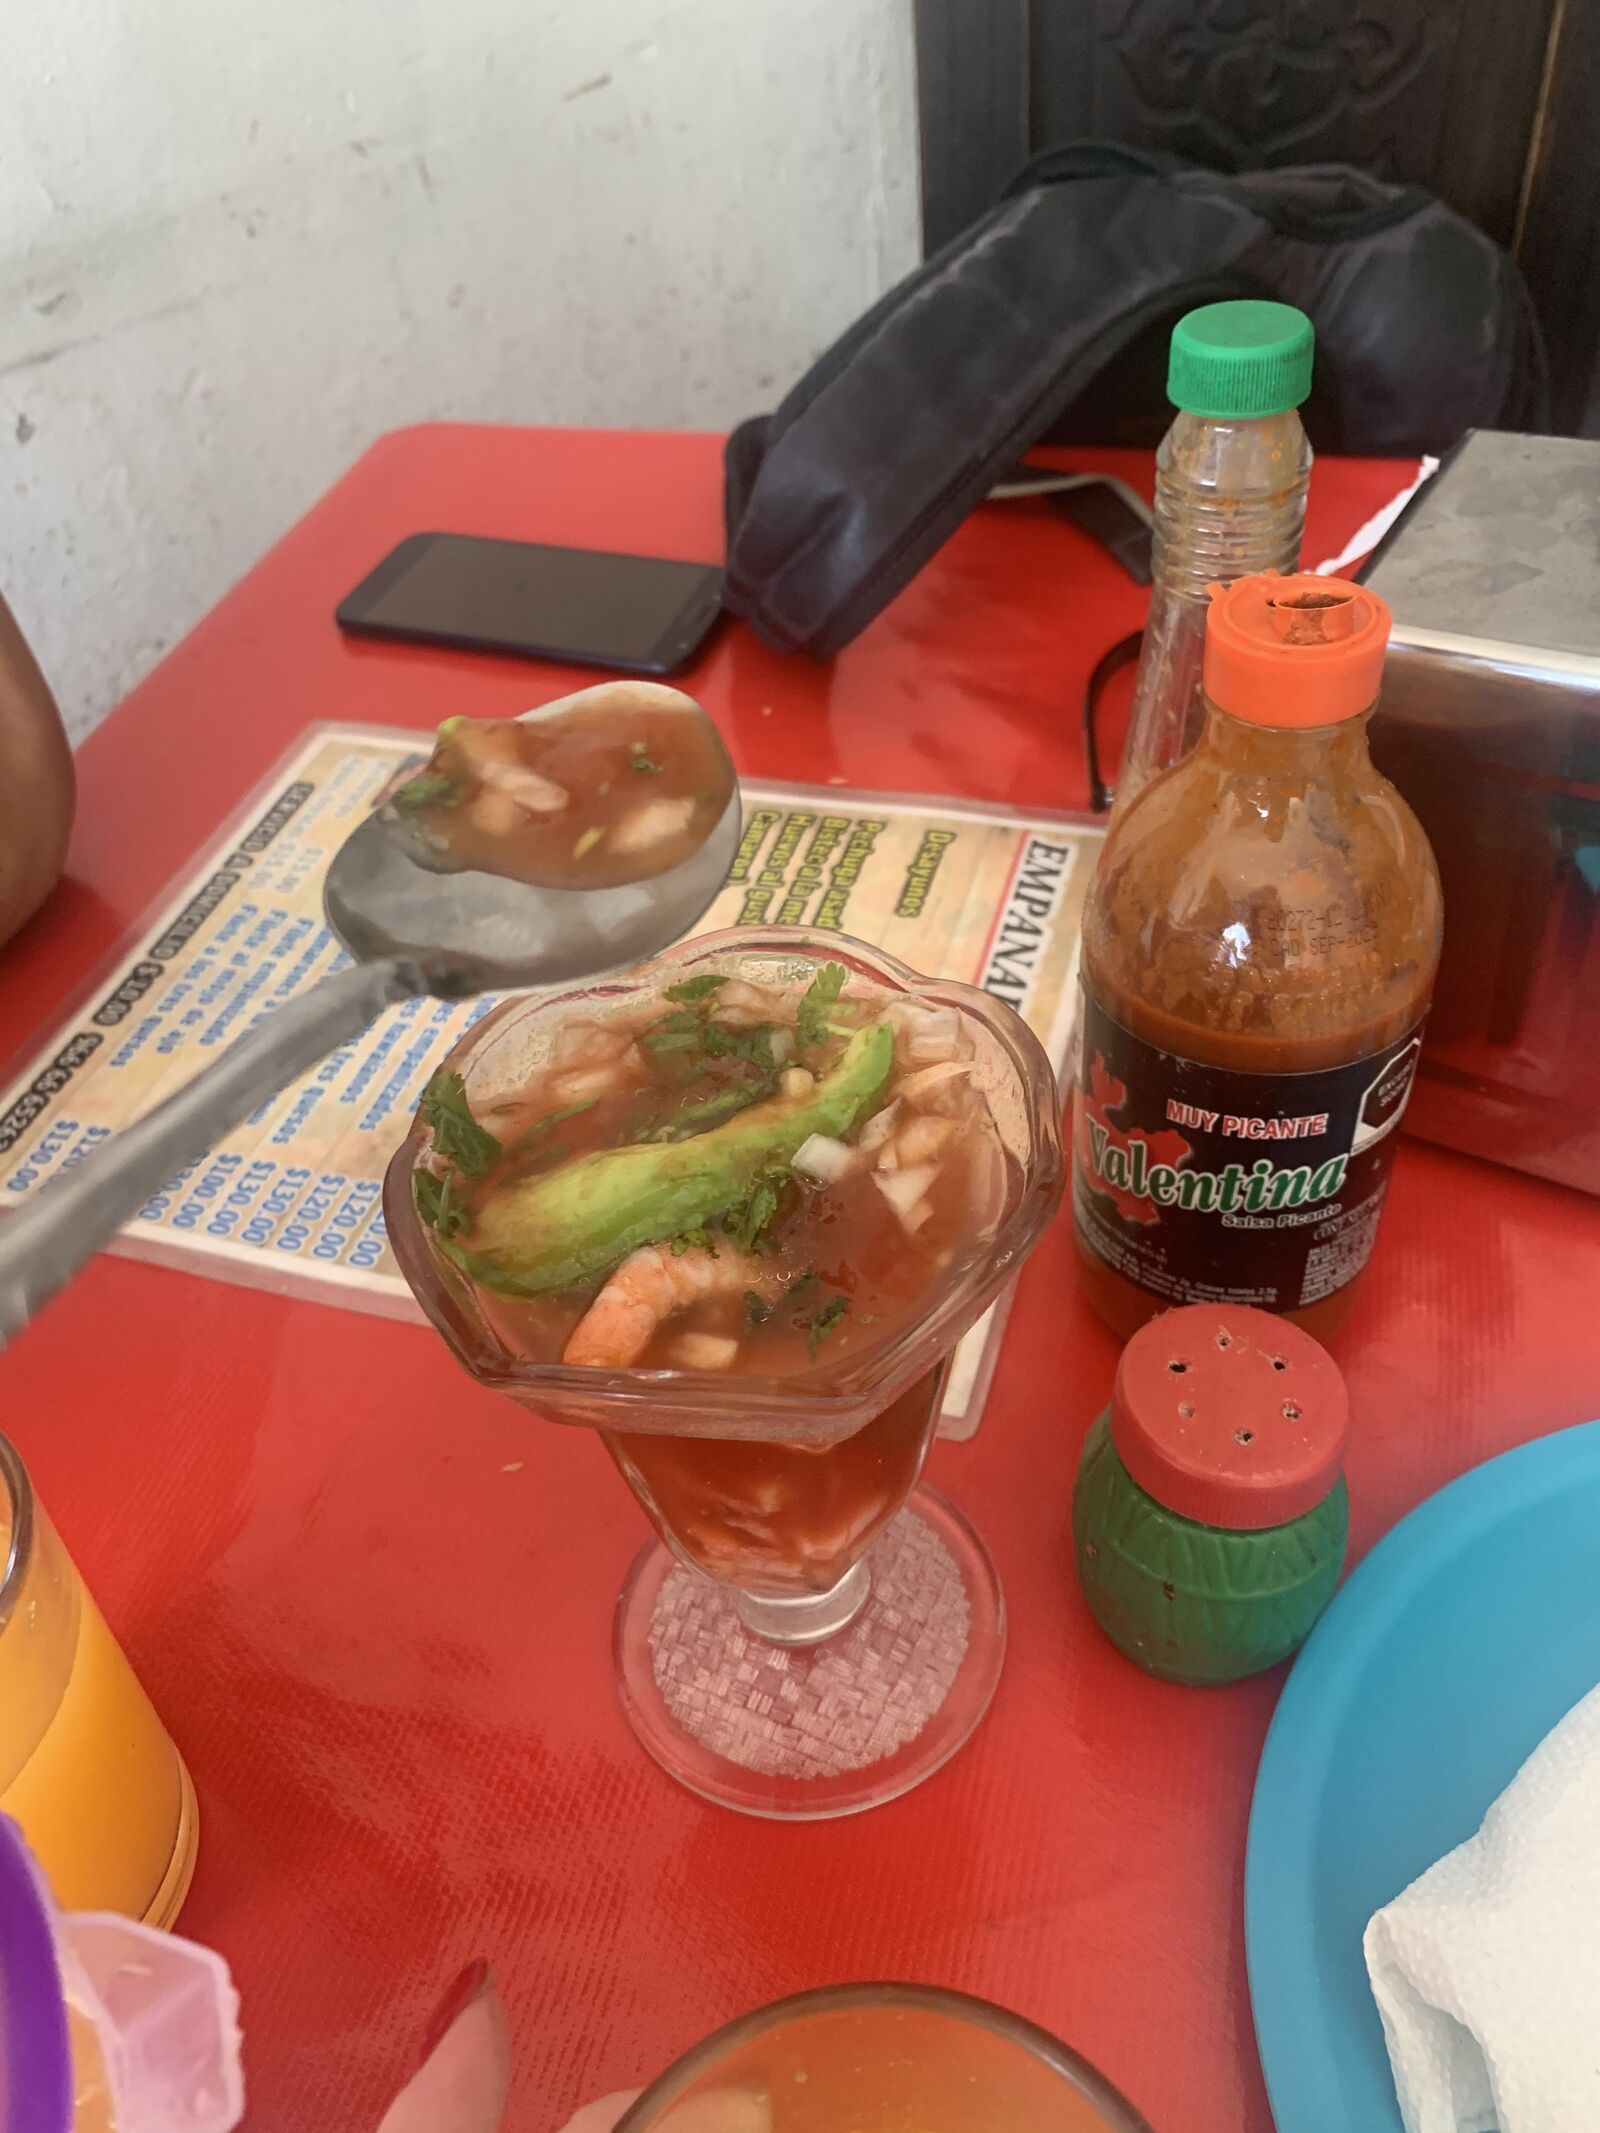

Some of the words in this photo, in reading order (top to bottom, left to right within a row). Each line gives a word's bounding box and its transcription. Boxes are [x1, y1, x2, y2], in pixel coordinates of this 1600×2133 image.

[766, 813, 817, 869] Huevos
[804, 816, 852, 865] Bistec
[831, 820, 887, 888] Pechuga
[895, 831, 957, 918] Desayunos
[736, 888, 774, 926] gust
[756, 870, 785, 887] al
[789, 880, 822, 897] la
[813, 889, 849, 929] asad
[149, 872, 240, 960] DOMICILIO
[984, 840, 1069, 1014] EMPANA
[340, 1022, 409, 1103] hawaianos
[359, 1027, 439, 1130] empanizados
[272, 1086, 324, 1144] quesos
[1166, 1099, 1219, 1133] MUY
[1222, 1113, 1329, 1141] PICANTE
[6, 1120, 79, 1192] $130.00
[171, 1152, 244, 1229] $100.00
[1086, 1112, 1349, 1213] Valentina
[206, 1160, 277, 1236] $130.00
[241, 1167, 311, 1243] $130.00
[276, 1174, 346, 1251] $120.00
[312, 1181, 381, 1260] $120.00
[1221, 1213, 1274, 1229] Salsa
[1276, 1203, 1342, 1227] Picante
